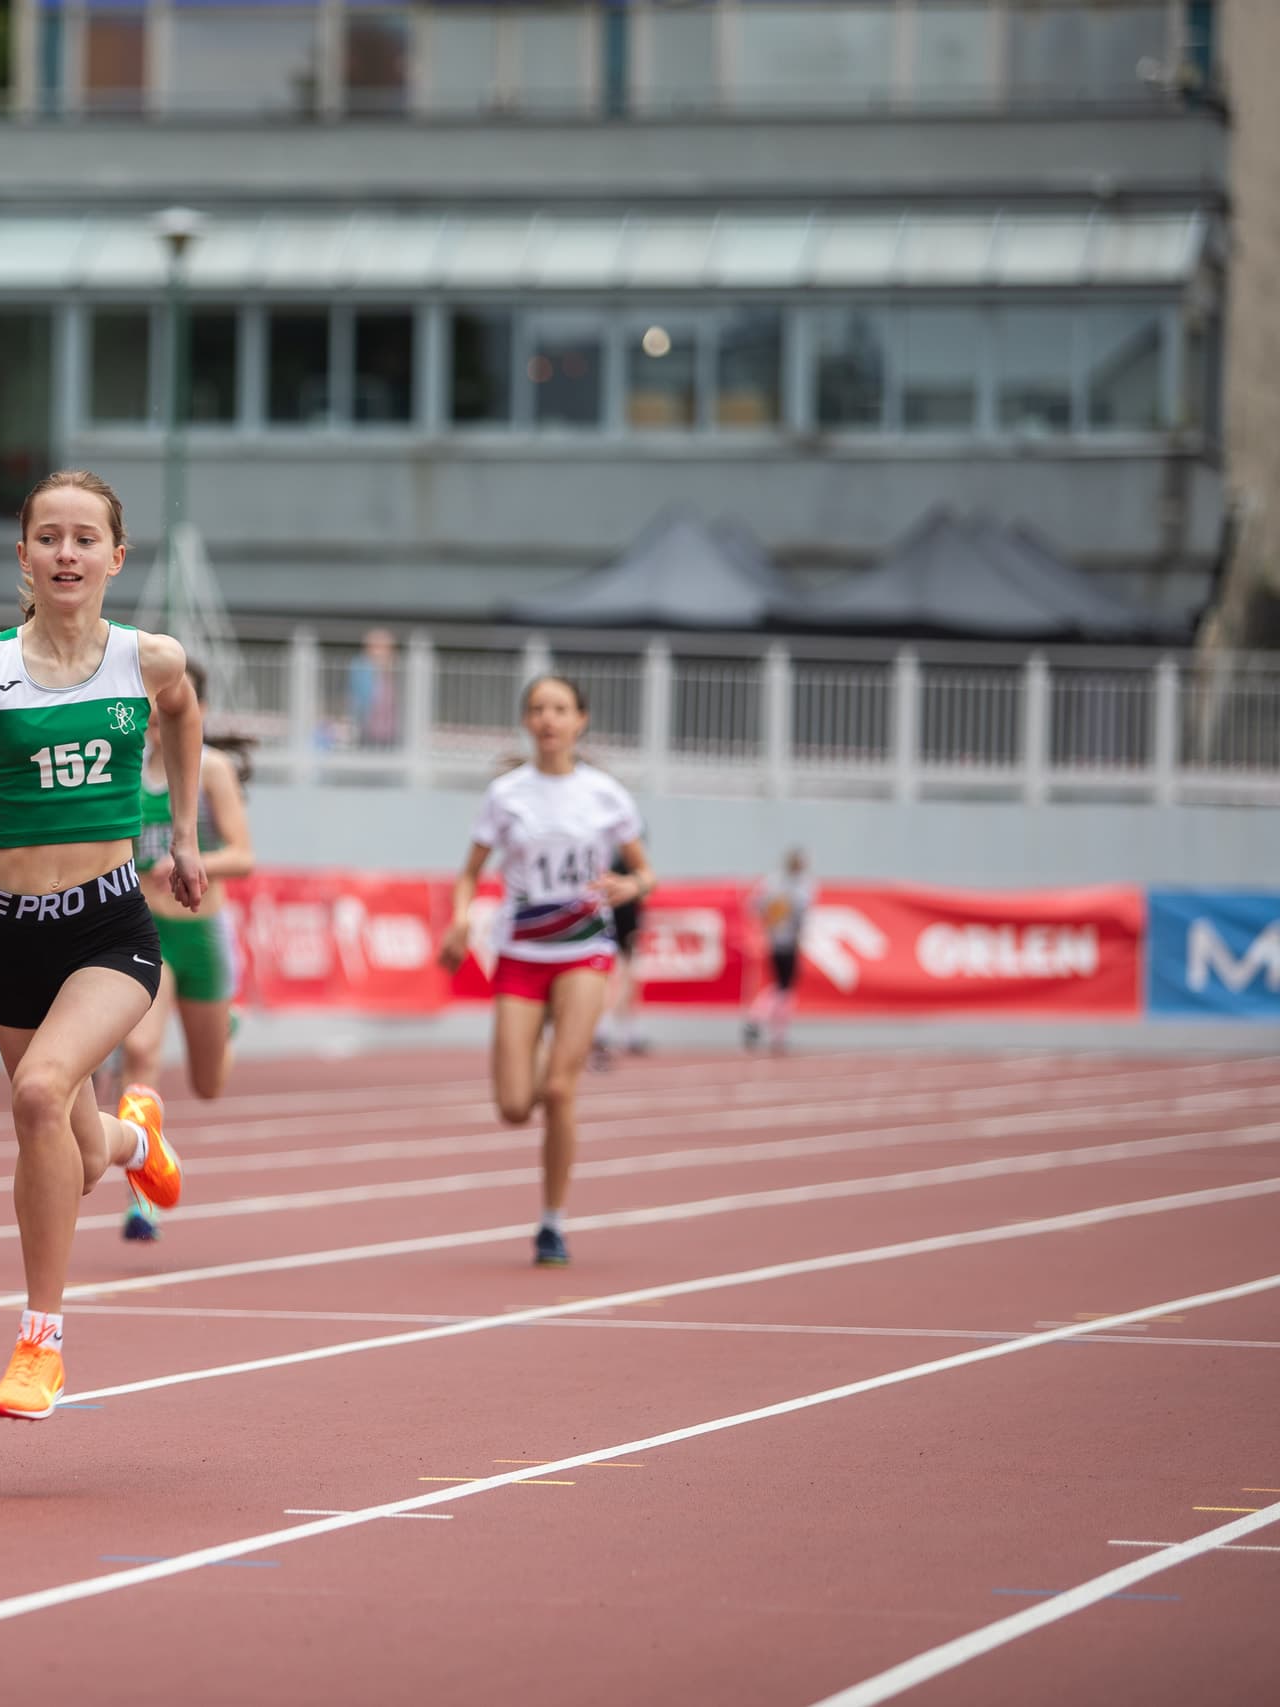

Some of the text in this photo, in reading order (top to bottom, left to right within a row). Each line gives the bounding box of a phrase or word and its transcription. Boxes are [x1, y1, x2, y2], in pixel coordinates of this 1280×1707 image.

[30, 739, 112, 788] 152
[16, 886, 85, 921] PRO
[914, 921, 1099, 979] ORLEN
